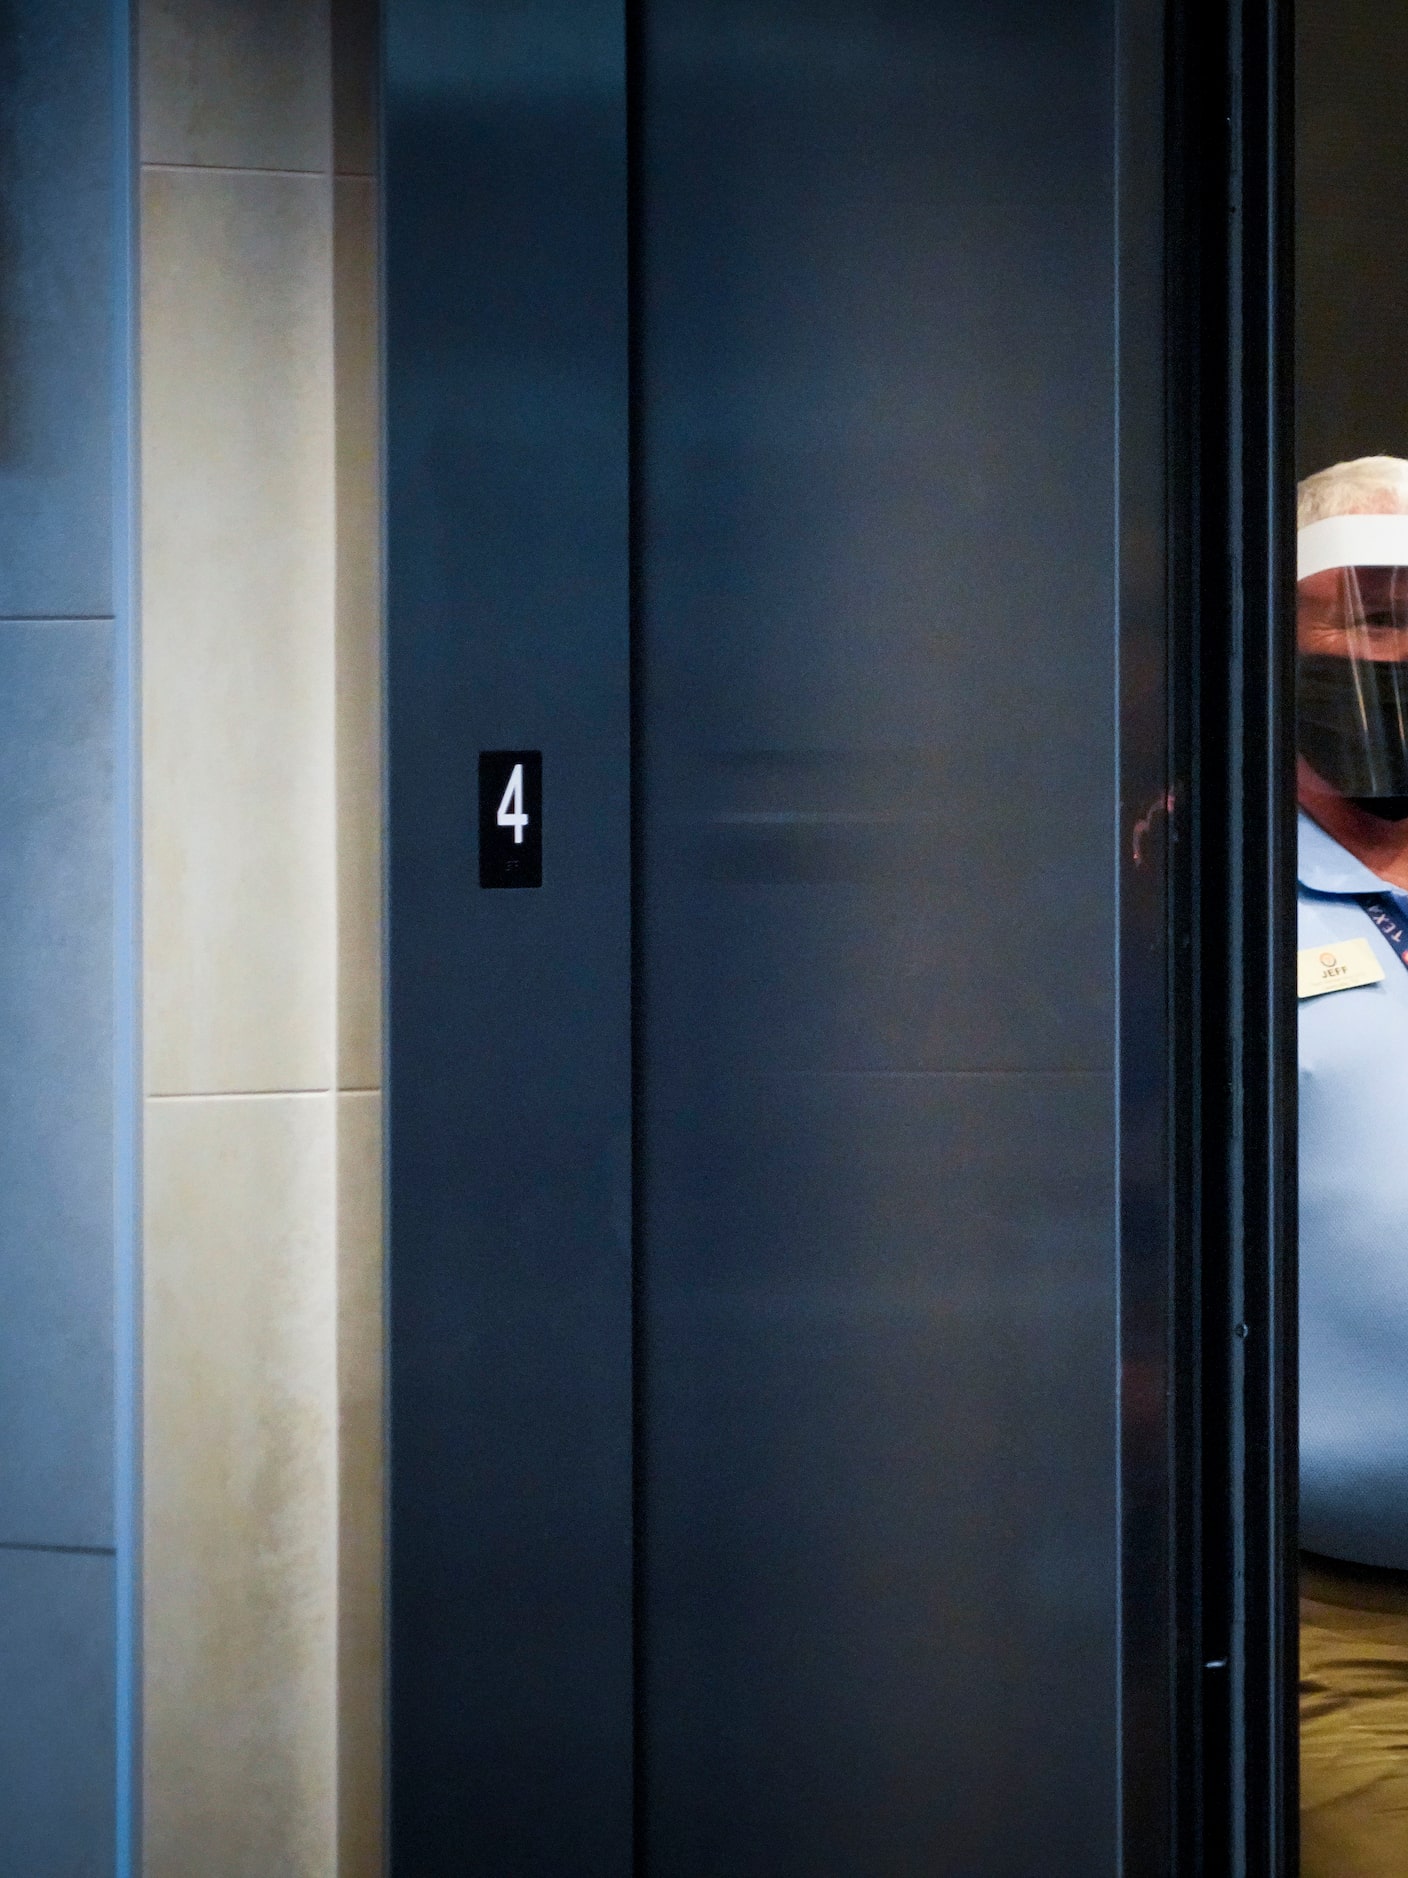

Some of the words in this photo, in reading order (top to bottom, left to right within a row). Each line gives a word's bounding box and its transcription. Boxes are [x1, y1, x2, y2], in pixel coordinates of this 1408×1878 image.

[497, 764, 528, 844] 4
[1368, 905, 1404, 942] TEXA
[1322, 965, 1348, 978] JEFF
